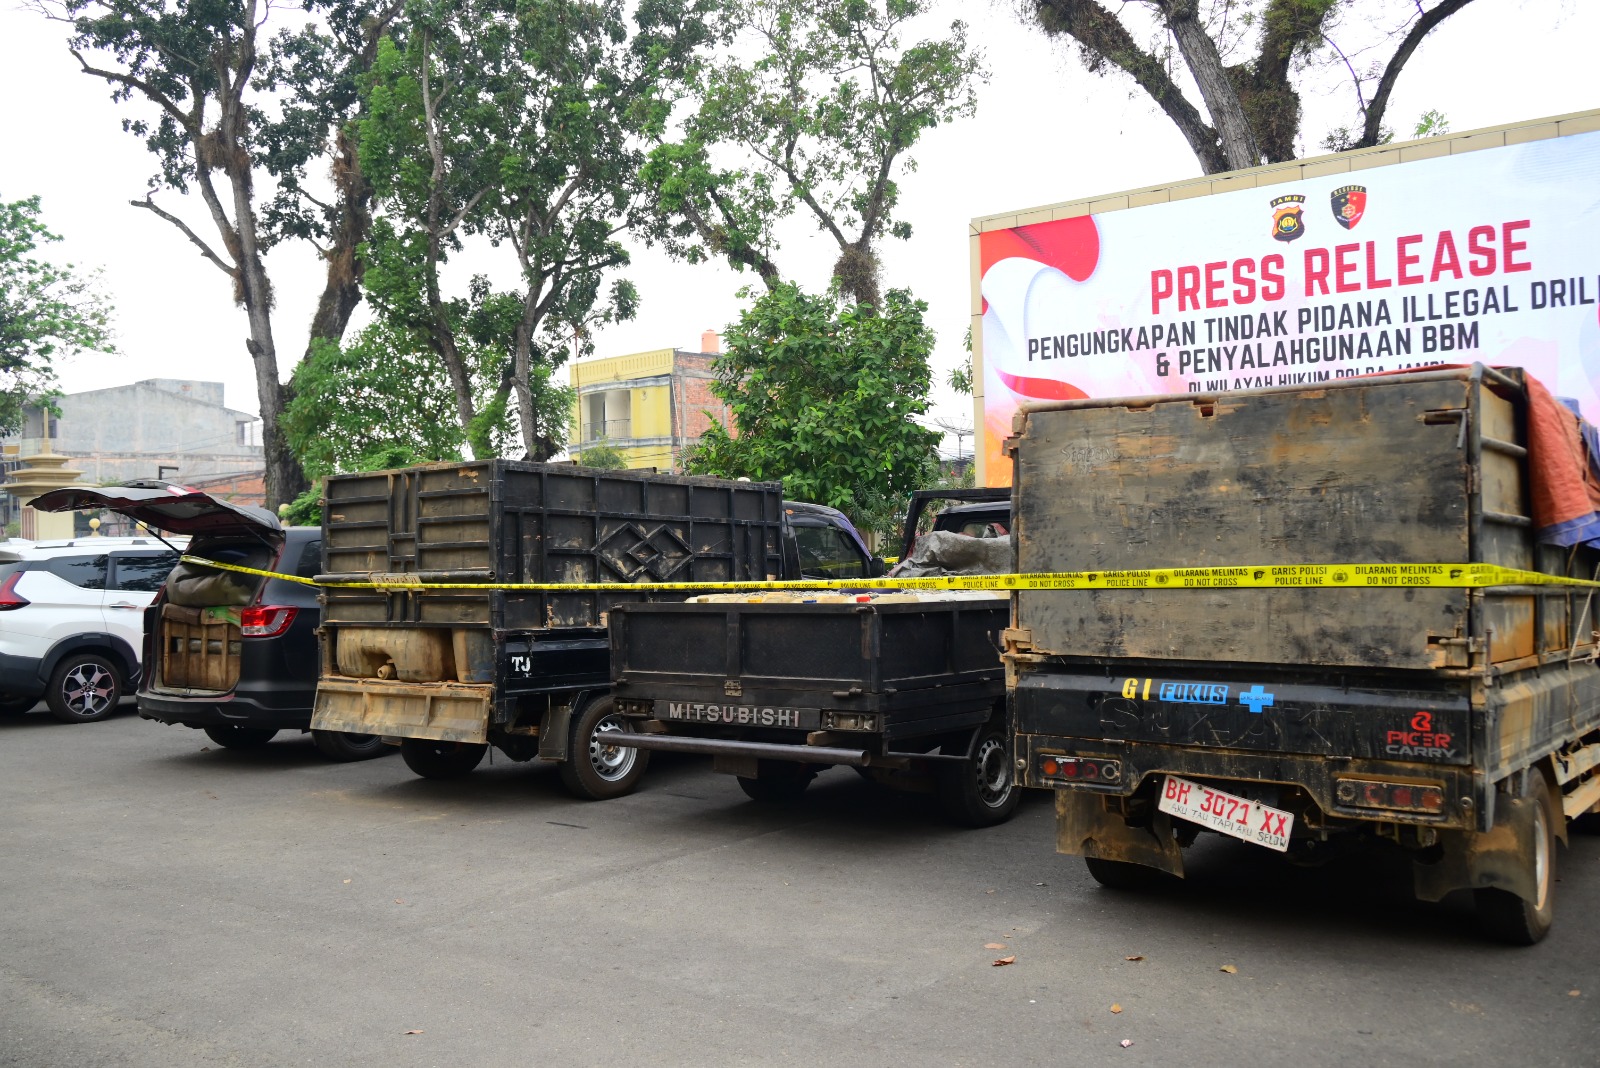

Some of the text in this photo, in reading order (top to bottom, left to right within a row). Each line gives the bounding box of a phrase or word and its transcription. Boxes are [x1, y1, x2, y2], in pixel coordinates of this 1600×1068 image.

[1272, 195, 1304, 206] JAMBI
[1151, 219, 1532, 314] PRESS RELEASE
[1028, 322, 1196, 361] PENGUNGKAPAN
[1204, 310, 1288, 344] TINDAK
[1298, 298, 1392, 334] PIDANA
[1402, 285, 1518, 324] ILLEGAL
[1156, 352, 1171, 377] &
[1179, 327, 1411, 375] PENYALAHGUNAAN
[1422, 320, 1480, 353] BBM
[1174, 568, 1248, 577] DILARANG MELINTAS
[1271, 566, 1328, 575] GARIS POLISI
[1355, 565, 1444, 575] DILARANG MELINTAS
[984, 580, 998, 588] LINE
[1029, 579, 1075, 588] DO NOT CROSS
[1106, 578, 1148, 587] POLICE LINE
[1184, 577, 1238, 586] DO NOT CROSS
[1274, 576, 1324, 585] POLICE LINE
[1366, 575, 1430, 585] DO NOT CROSS
[511, 656, 531, 672] TJ
[1160, 682, 1229, 704] FOKUS
[669, 702, 799, 727] MITSUBISHI
[1385, 744, 1457, 758] CARRY
[1200, 789, 1250, 825] 3071
[1260, 809, 1288, 838] XX
[1171, 803, 1188, 816] AKU
[1191, 808, 1209, 821] TAU
[1212, 815, 1234, 831] TAPI
[1235, 824, 1253, 837] AKU
